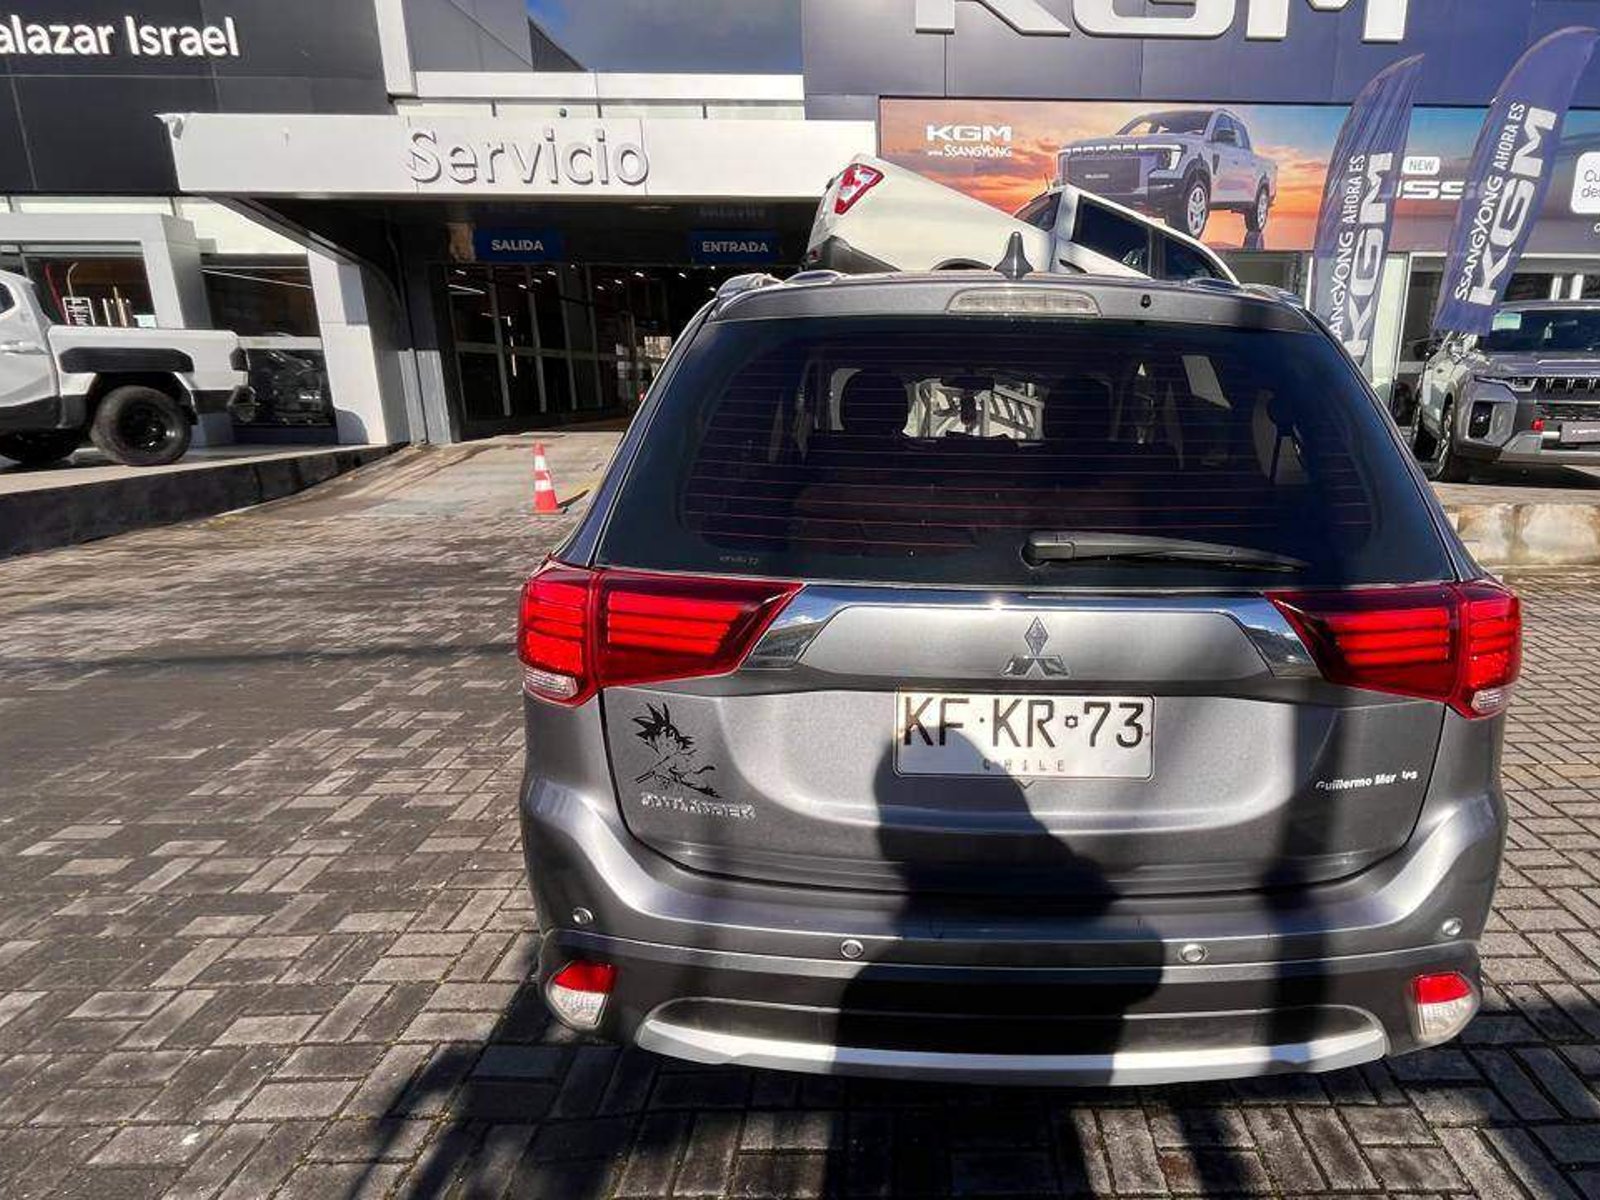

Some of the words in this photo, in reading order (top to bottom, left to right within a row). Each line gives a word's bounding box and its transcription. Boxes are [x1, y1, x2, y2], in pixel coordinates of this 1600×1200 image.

[125, 16, 240, 57] Israel
[927, 125, 1012, 141] KGM
[407, 127, 650, 187] Servicio
[944, 144, 1012, 158] SSANGYONG
[1348, 154, 1365, 173] ES
[1408, 159, 1435, 171] NEW
[1342, 176, 1362, 224] AHORA
[1455, 174, 1503, 301] SSANGYONG
[1493, 124, 1519, 171] AHORA
[1508, 102, 1525, 121] ES
[1468, 107, 1557, 305] KGM
[490, 239, 544, 251] SALIDA
[702, 241, 769, 253] ENTRADA
[1343, 152, 1393, 357] KGM
[982, 759, 1066, 772] CHILE
